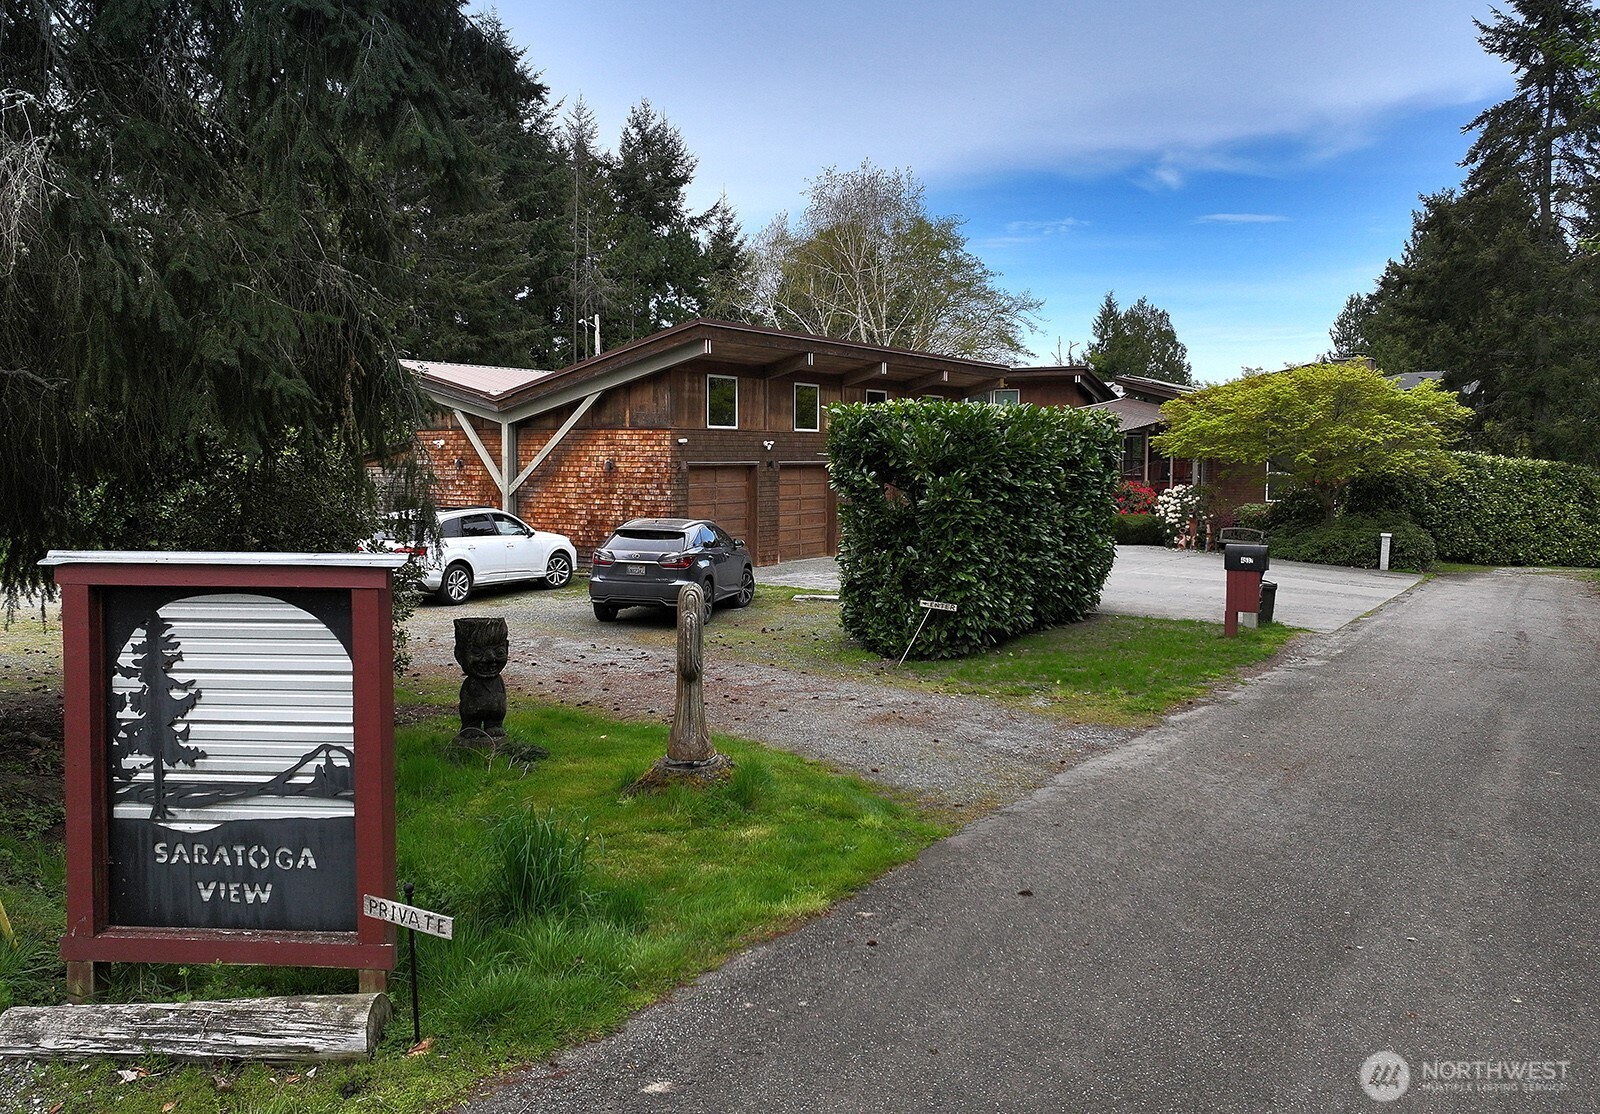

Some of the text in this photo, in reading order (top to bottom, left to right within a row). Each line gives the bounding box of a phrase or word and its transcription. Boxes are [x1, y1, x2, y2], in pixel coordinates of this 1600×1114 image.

[930, 602, 956, 611] ENTER
[154, 842, 317, 870] SARATOGA
[196, 881, 273, 904] VIEW
[369, 899, 447, 935] PRIVATE
